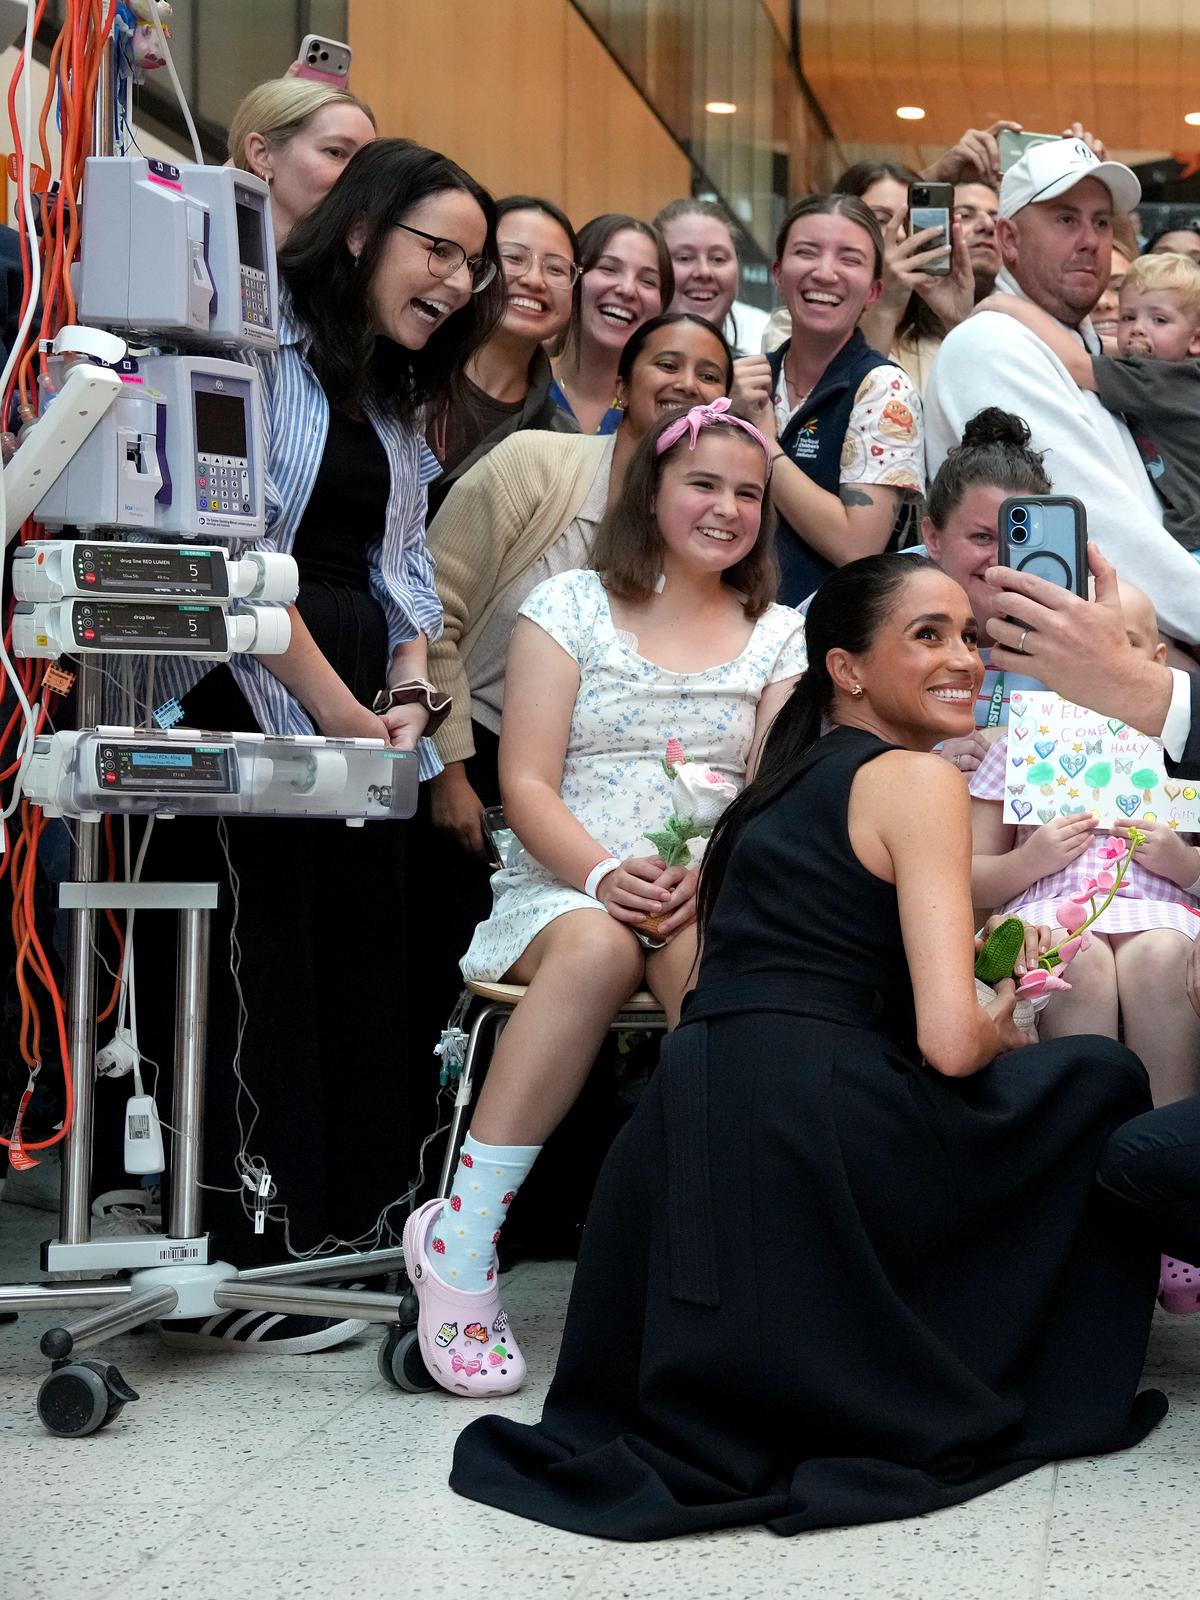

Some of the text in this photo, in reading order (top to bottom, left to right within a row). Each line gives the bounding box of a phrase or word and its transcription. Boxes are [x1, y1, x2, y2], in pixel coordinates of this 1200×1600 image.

[188, 563, 199, 577] 5
[188, 619, 198, 632] 5
[987, 684, 1004, 728] ISITOR
[1061, 723, 1108, 743] COME
[1111, 743, 1150, 760] HARRY
